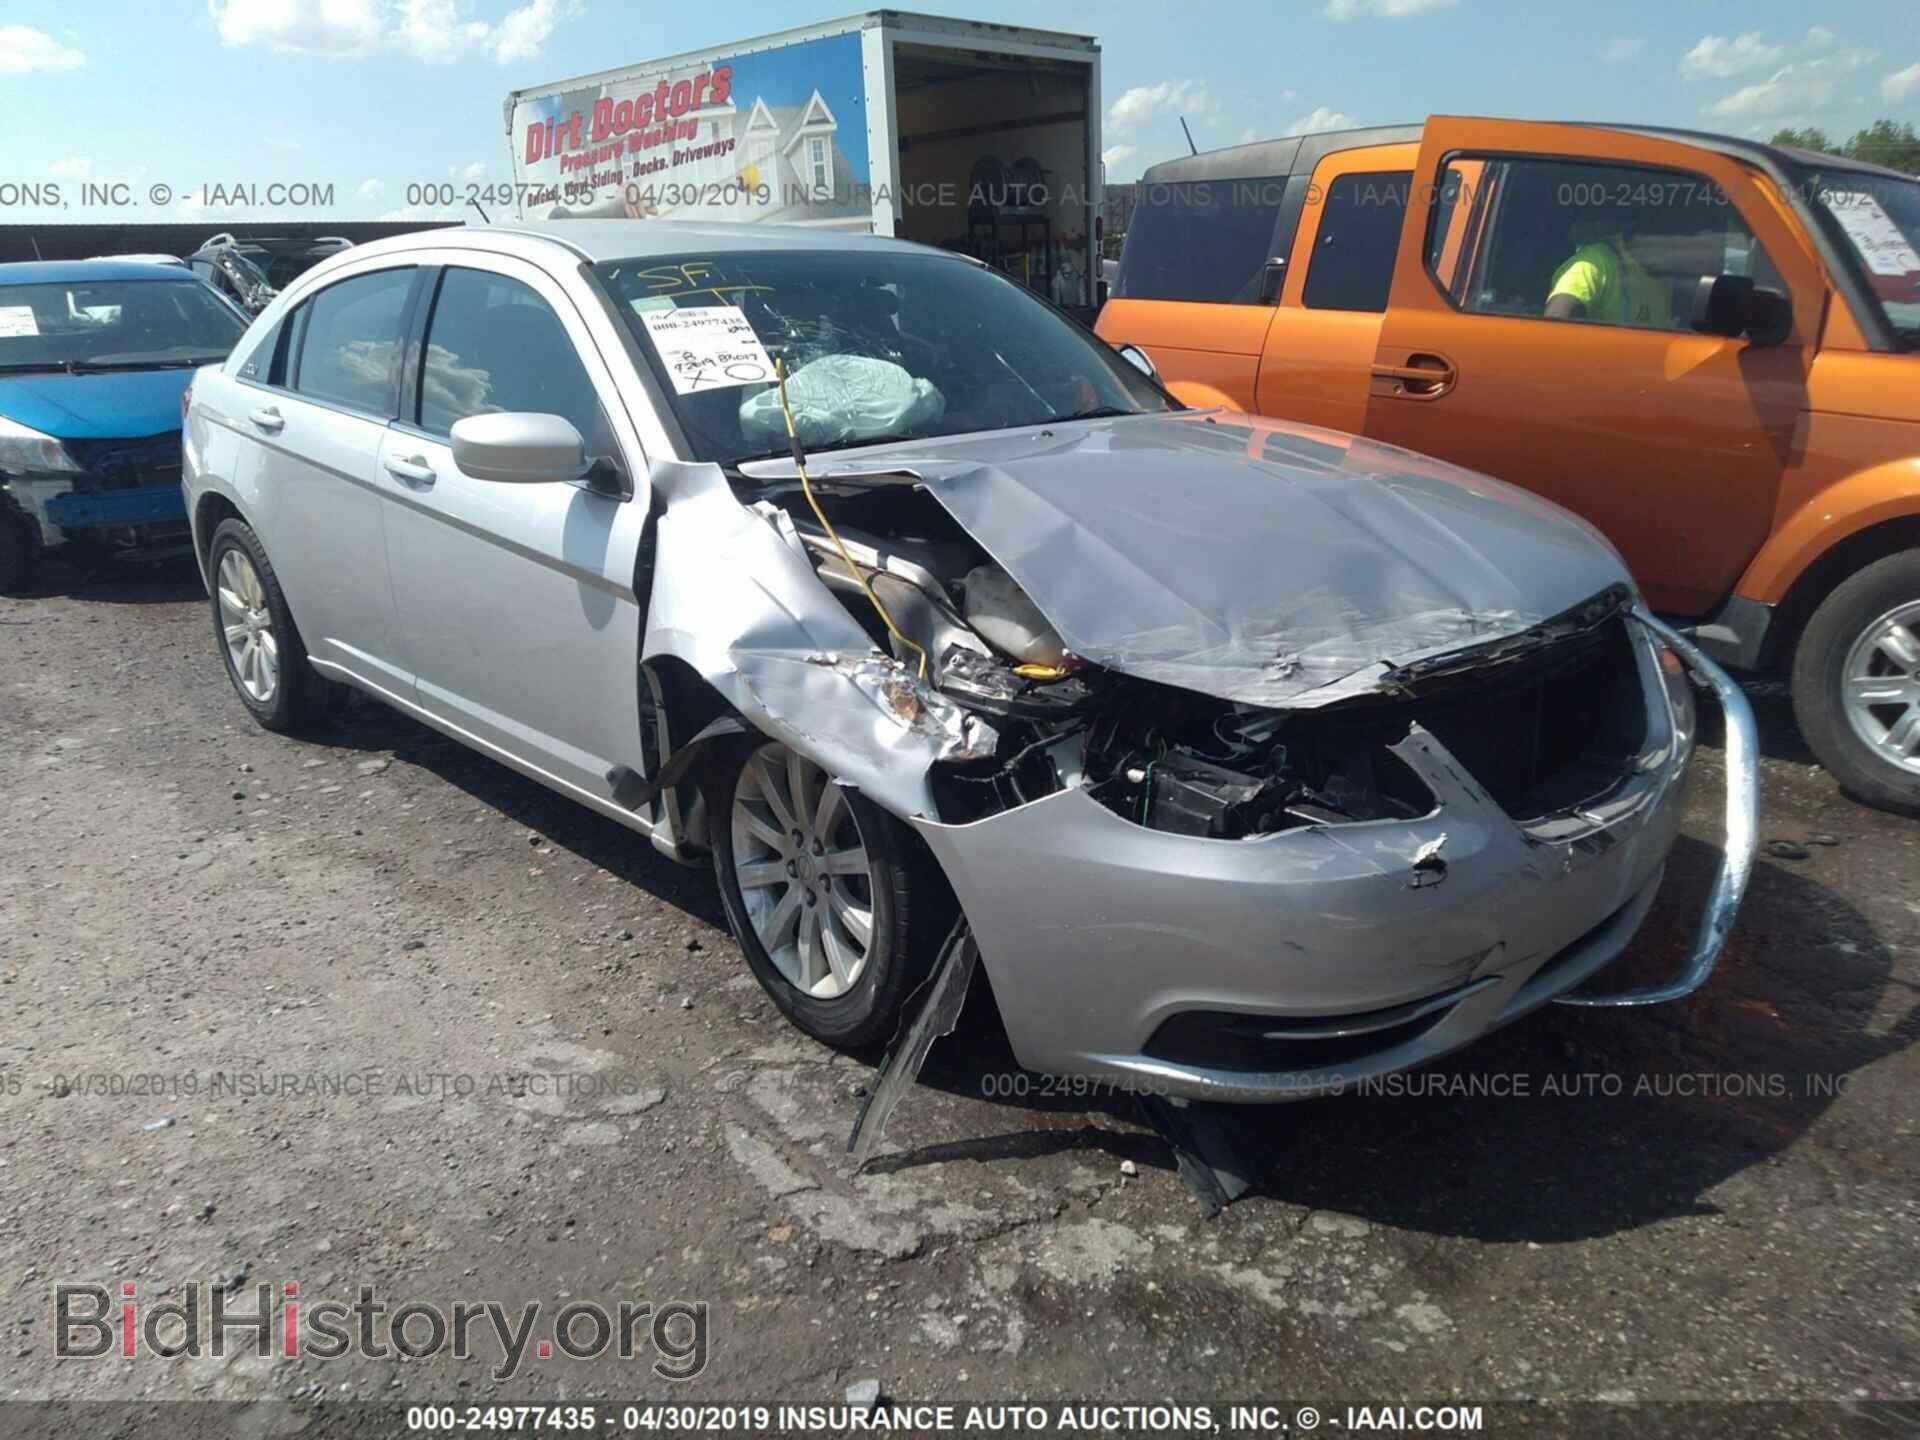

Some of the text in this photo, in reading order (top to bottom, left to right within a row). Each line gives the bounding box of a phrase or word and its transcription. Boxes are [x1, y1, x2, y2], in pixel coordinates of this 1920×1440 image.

[525, 65, 734, 165] Dirt Doctors
[560, 118, 699, 175] Pressure Washing
[633, 155, 668, 177] Decks.
[672, 137, 736, 167] Driveways
